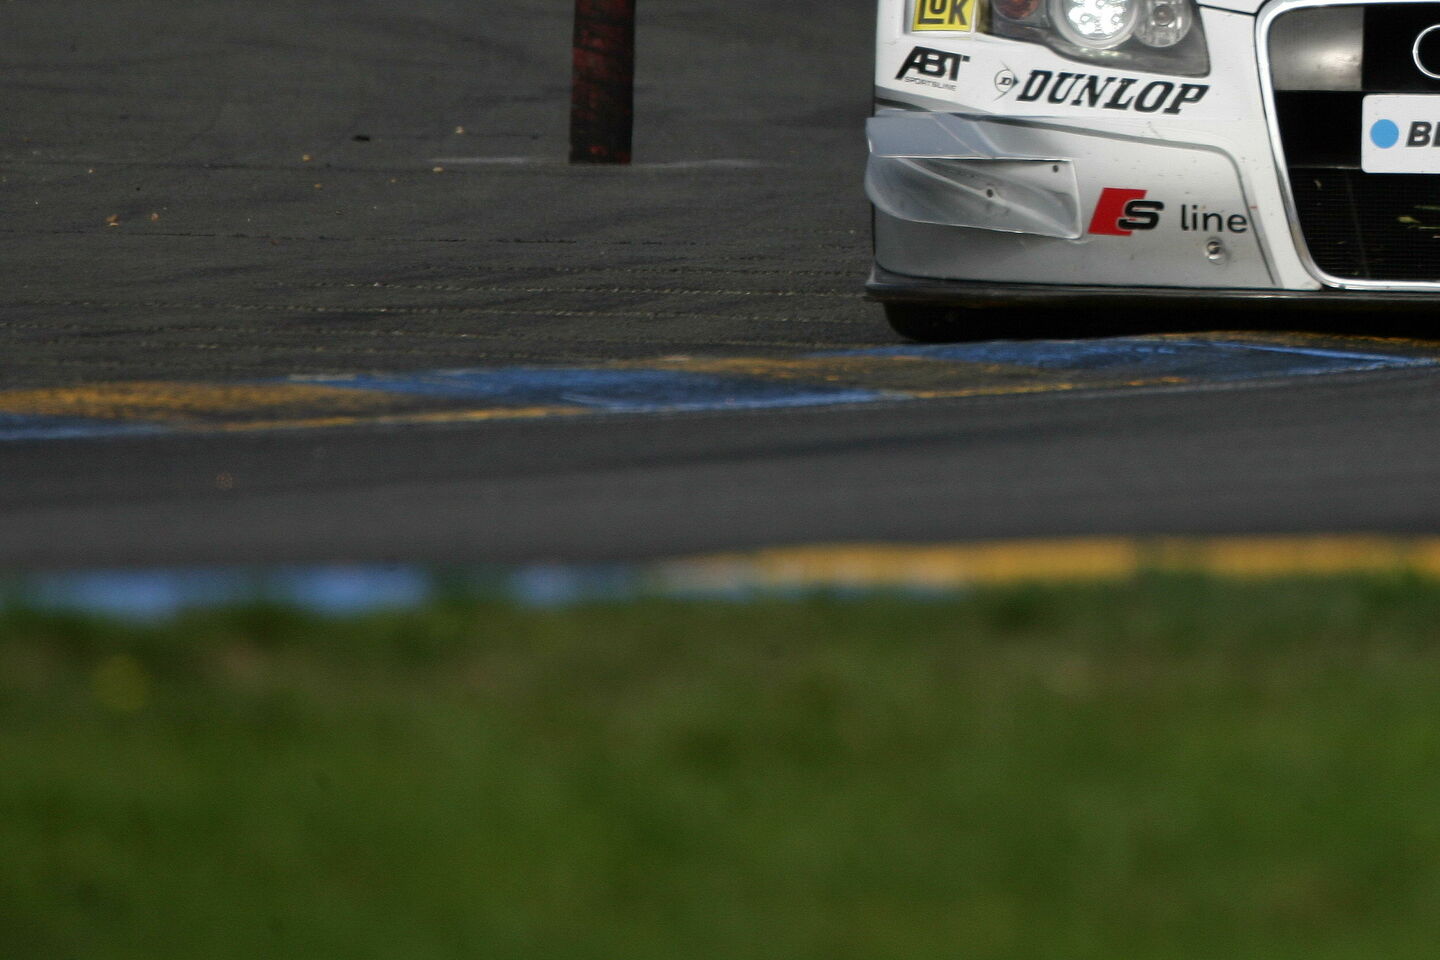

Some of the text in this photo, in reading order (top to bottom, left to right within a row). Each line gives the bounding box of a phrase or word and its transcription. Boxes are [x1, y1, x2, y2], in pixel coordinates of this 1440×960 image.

[895, 46, 970, 81] ABT
[904, 75, 957, 92] SPORTSLINE
[1016, 69, 1209, 115] DUNLOP
[1117, 199, 1248, 234] S line
